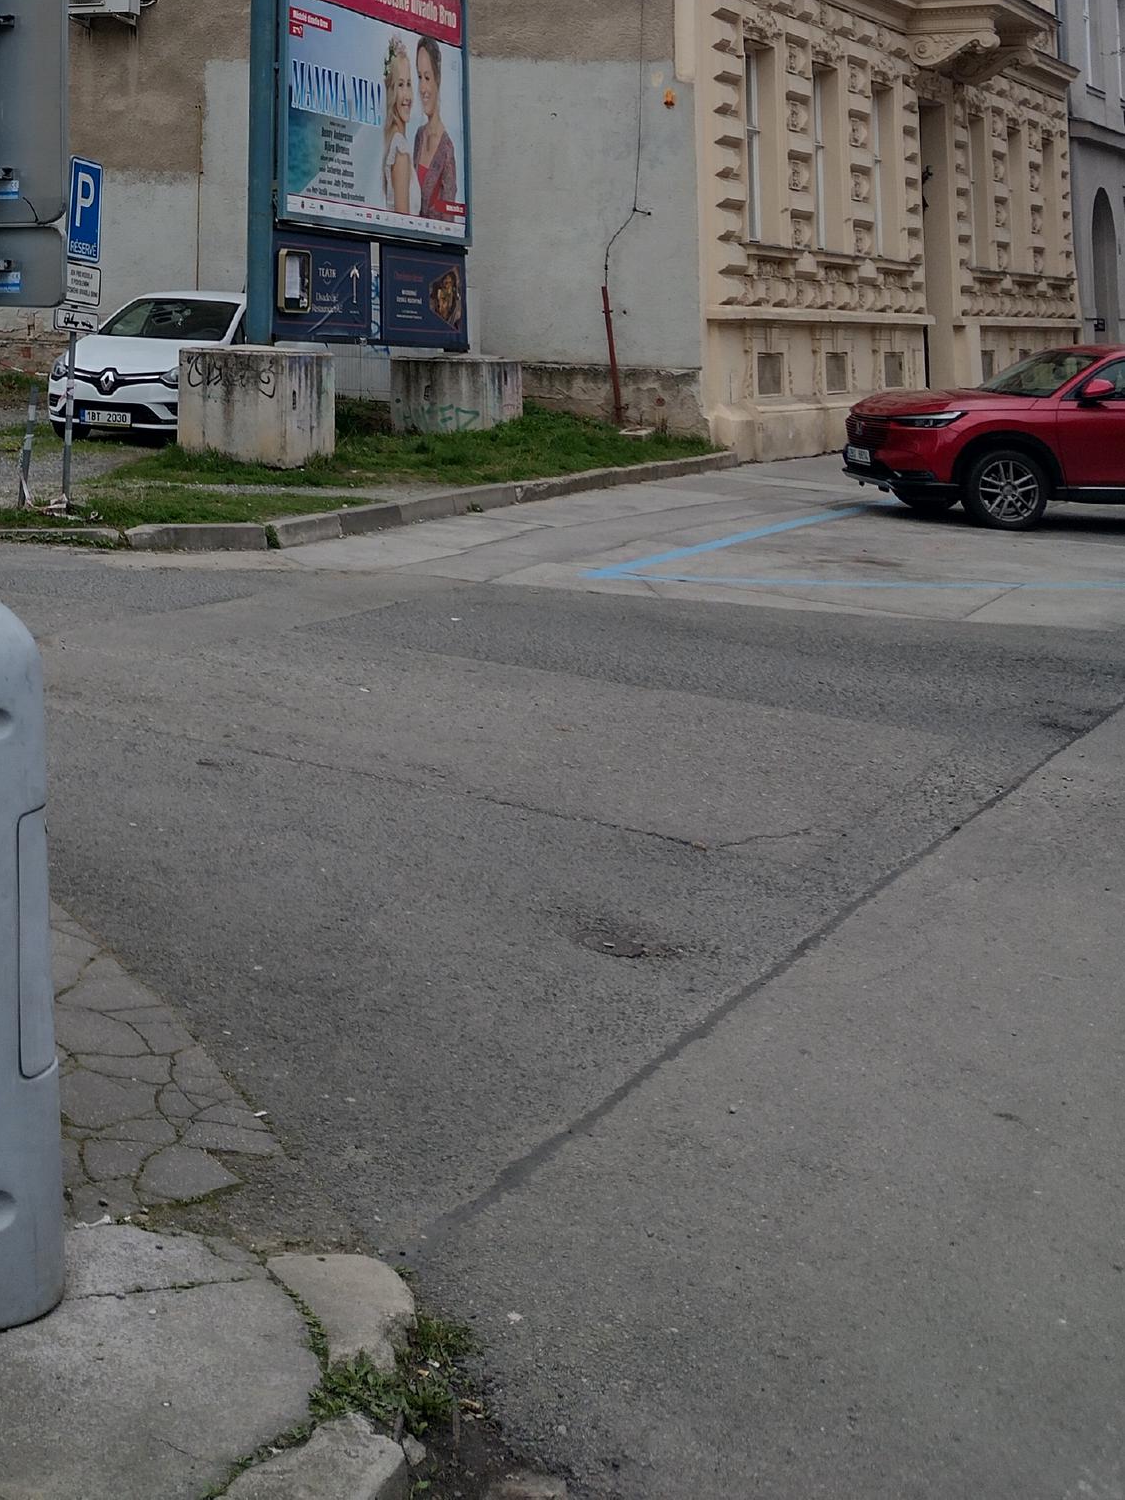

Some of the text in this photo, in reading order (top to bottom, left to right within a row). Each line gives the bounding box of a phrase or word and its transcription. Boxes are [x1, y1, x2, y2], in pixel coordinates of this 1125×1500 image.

[439, 4, 457, 28] Brno
[291, 58, 382, 128] MAMMA MIA!
[74, 171, 95, 227] P
[87, 411, 127, 423] 1BT 2030
